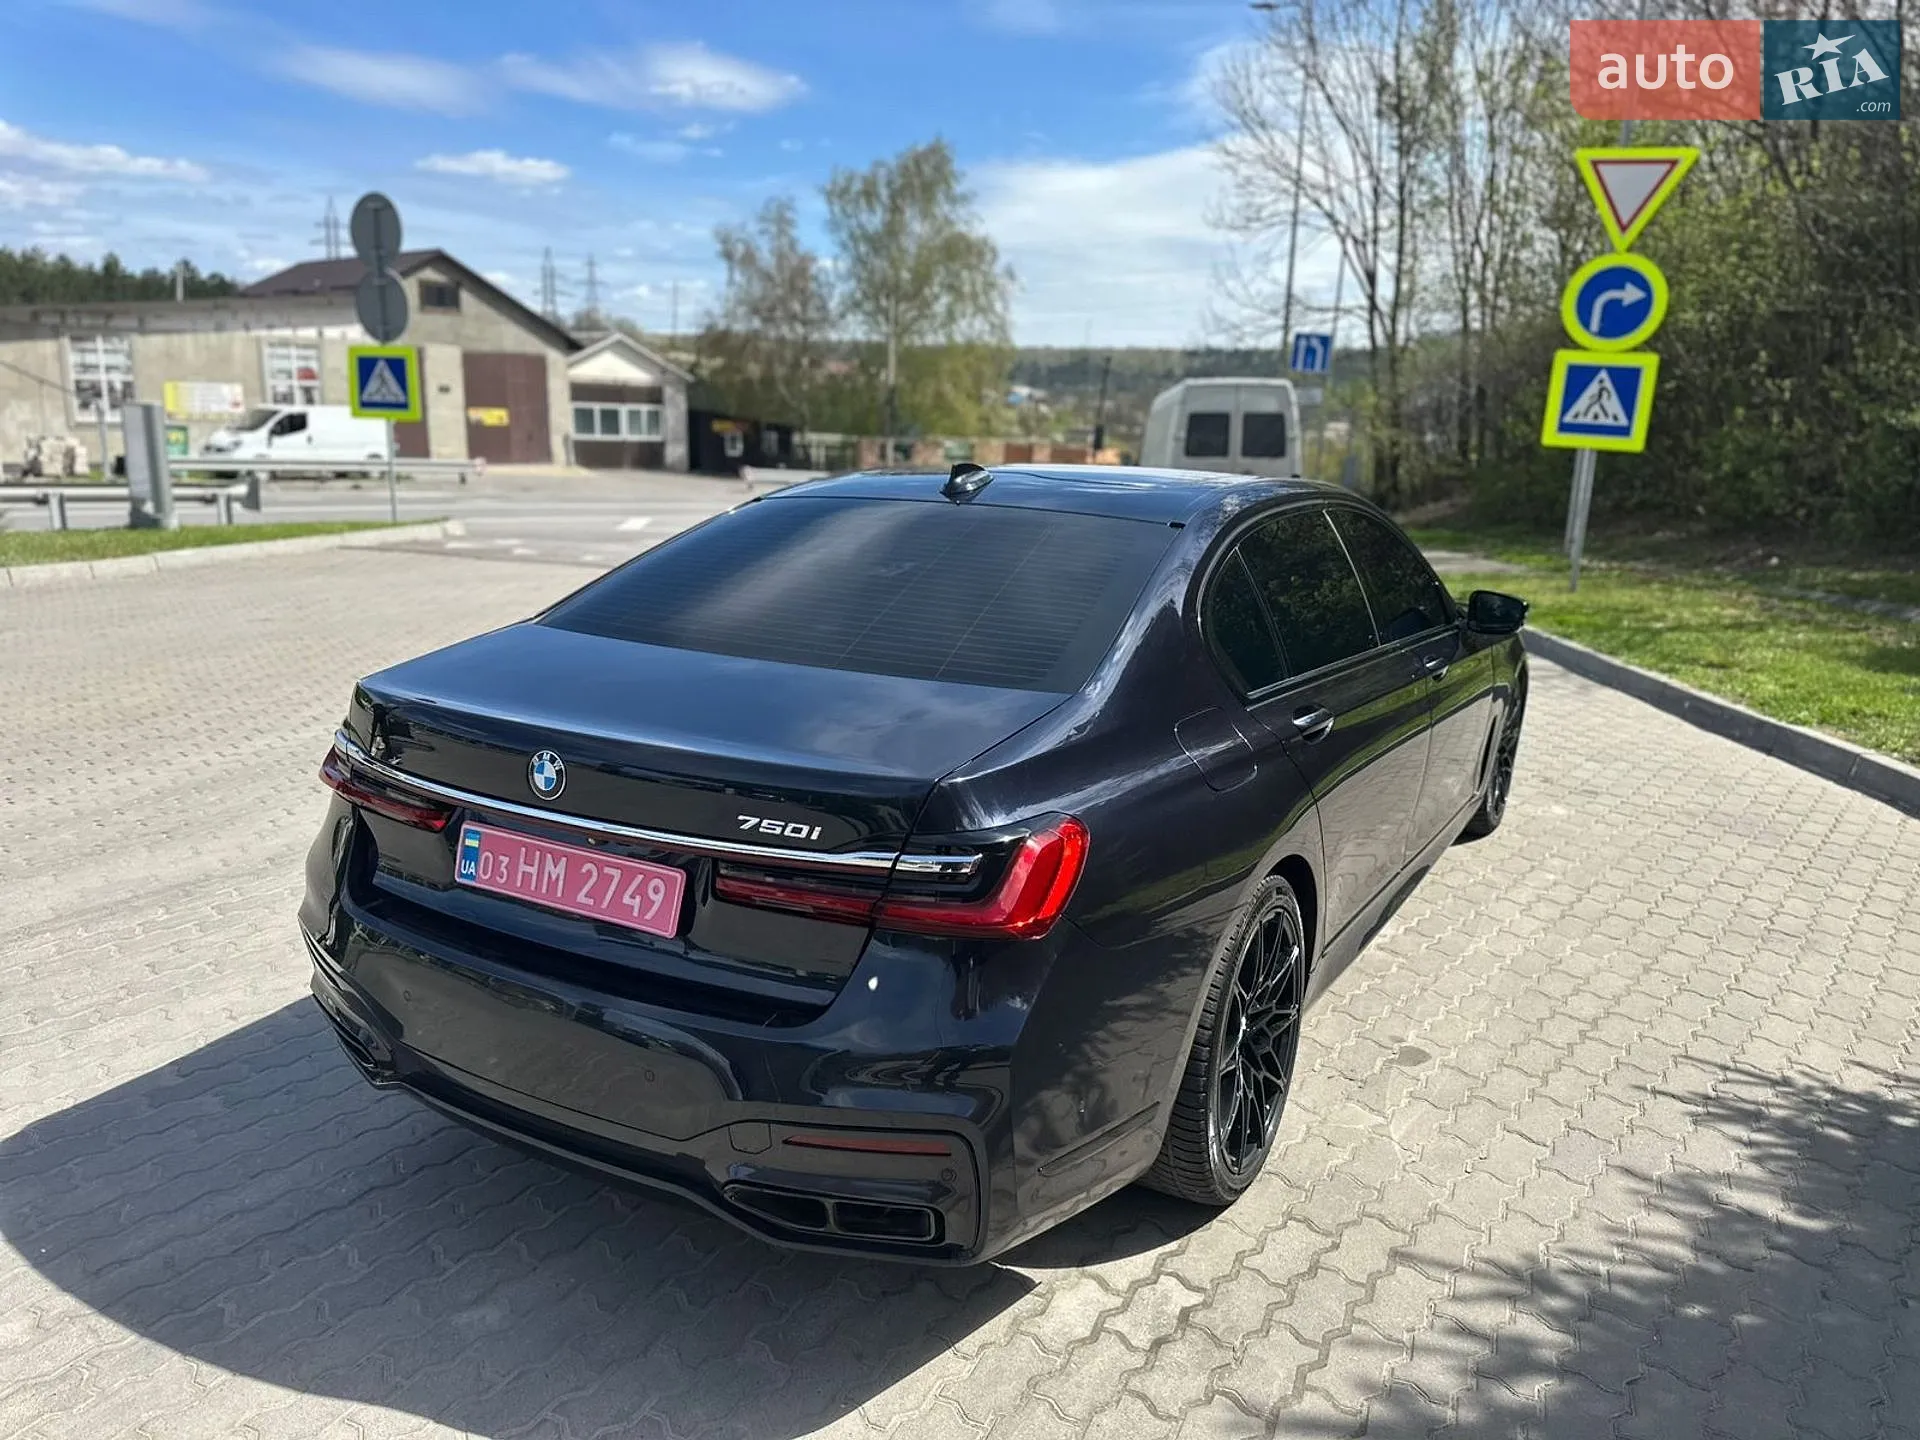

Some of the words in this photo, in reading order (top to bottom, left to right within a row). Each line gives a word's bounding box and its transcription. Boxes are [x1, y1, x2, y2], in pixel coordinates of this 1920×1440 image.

[460, 860, 477, 876] UA
[479, 852, 510, 884] 03
[516, 847, 568, 898] HM
[576, 863, 666, 921] 2749
